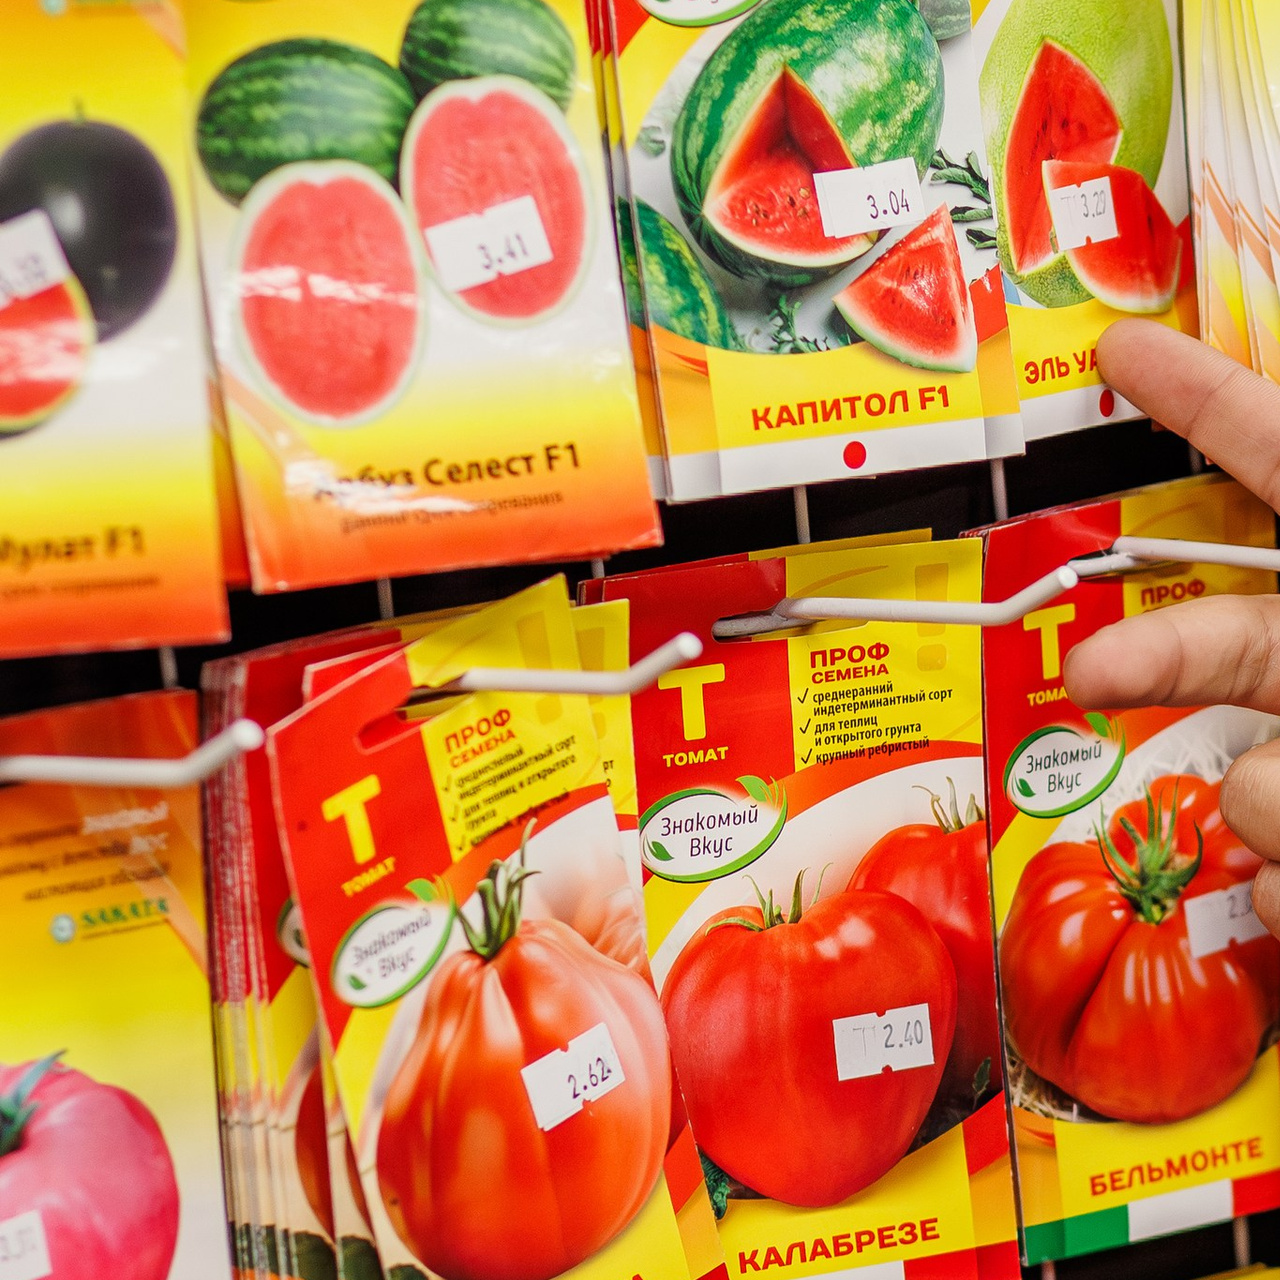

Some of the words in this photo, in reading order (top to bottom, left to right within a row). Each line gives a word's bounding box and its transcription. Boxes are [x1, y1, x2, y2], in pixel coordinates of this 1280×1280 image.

[866, 188, 911, 220] 3.04
[1023, 355, 1072, 386] ЭЛЬ
[750, 390, 911, 432] КАПИТОЛ
[917, 383, 951, 412] F1
[422, 453, 535, 489] Селест
[543, 440, 581, 473] F1
[1140, 578, 1207, 607] ПРОФ
[809, 641, 891, 669] ПРОФ
[1022, 602, 1077, 681] Т
[811, 662, 890, 686] СЕМЕНА
[657, 662, 726, 741] Т
[812, 680, 894, 706] среднеранний
[813, 689, 927, 718] индетерминантный
[927, 687, 954, 704] сорт
[444, 708, 513, 755] ПРОФ
[814, 721, 836, 736] для
[837, 714, 879, 732] теплиц
[823, 728, 884, 749] открытого
[884, 720, 923, 741] грунта
[450, 729, 517, 770] СЕМЕНА
[662, 745, 729, 769] ТОМАТ
[815, 747, 867, 766] крупный
[867, 735, 931, 758] ребристый
[1025, 739, 1103, 775] Знакомый
[1047, 770, 1083, 795] Вкус
[321, 773, 382, 866] Т
[660, 804, 760, 837] Знакомый
[689, 836, 734, 859] Вкус
[341, 856, 398, 898] ТОМАТ
[882, 1018, 925, 1050] 2.40
[566, 1057, 606, 1101] 2.62
[1089, 1135, 1266, 1198] БЕЛЬМОНТЕ
[737, 1217, 941, 1276] КАЛАБРЕЗЕ
